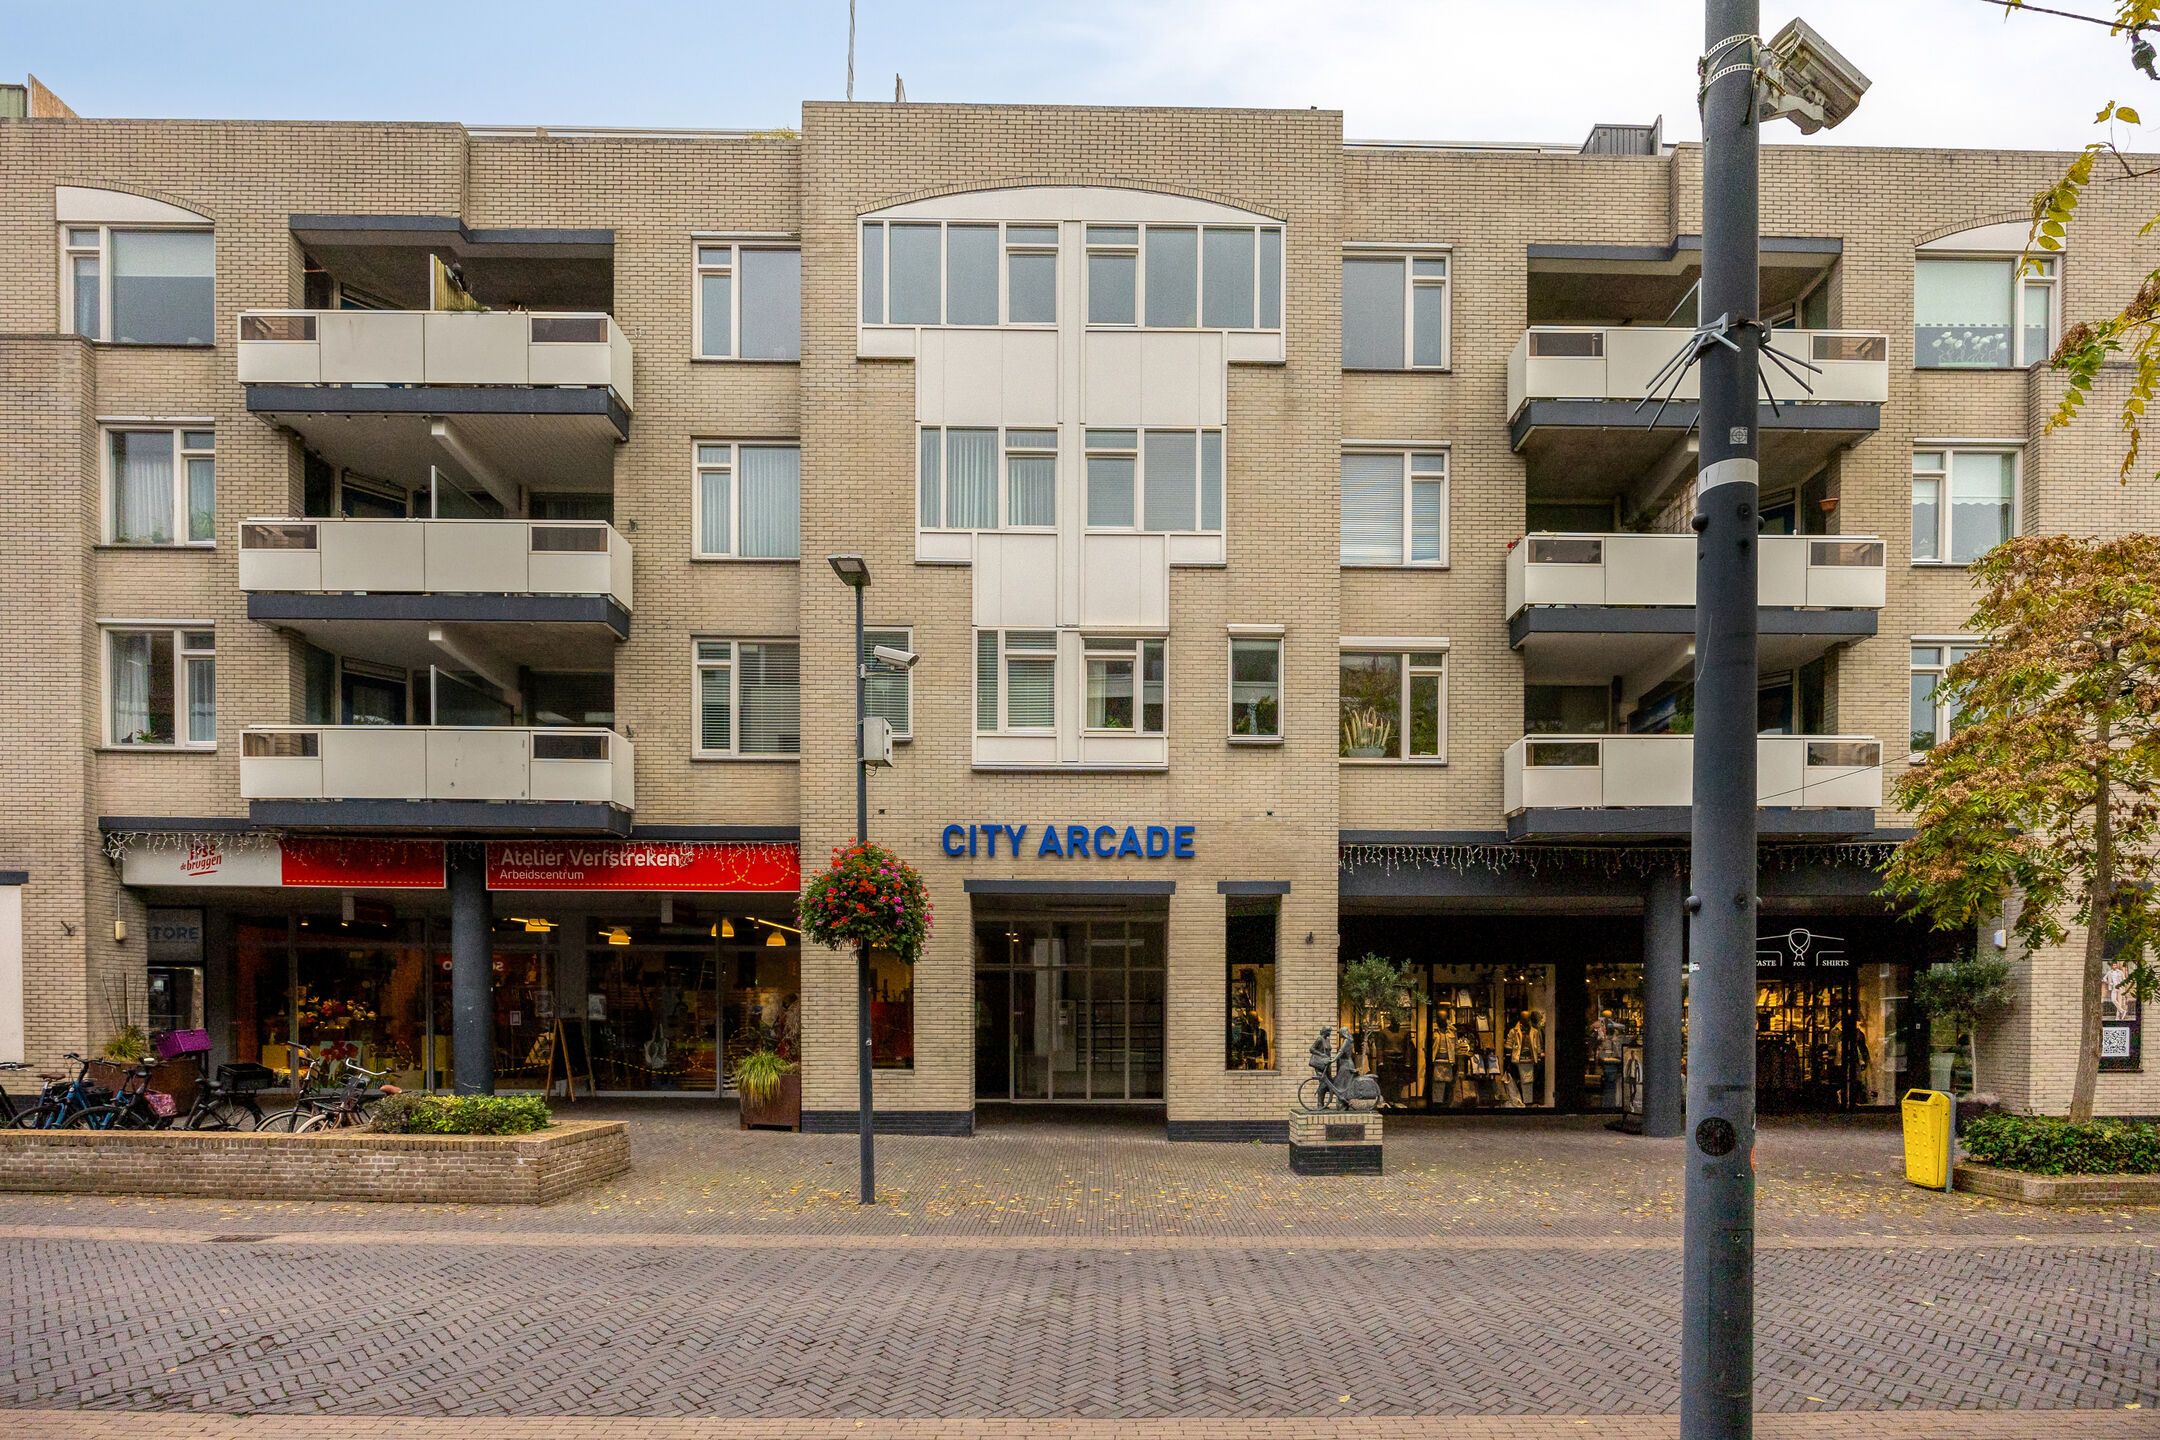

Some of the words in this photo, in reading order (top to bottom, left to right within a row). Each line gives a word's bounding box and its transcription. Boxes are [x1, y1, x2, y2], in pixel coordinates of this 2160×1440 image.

[942, 823, 1027, 859] CITY
[1037, 825, 1196, 859] ARCADE
[190, 844, 216, 861] ipse
[500, 849, 564, 867] Atelier
[569, 849, 681, 868] Verfstreken
[186, 854, 222, 871] bruggen
[499, 869, 585, 881] Arbeidscentrum
[147, 926, 200, 940] TORE
[1822, 959, 1849, 967] SHIRTS
